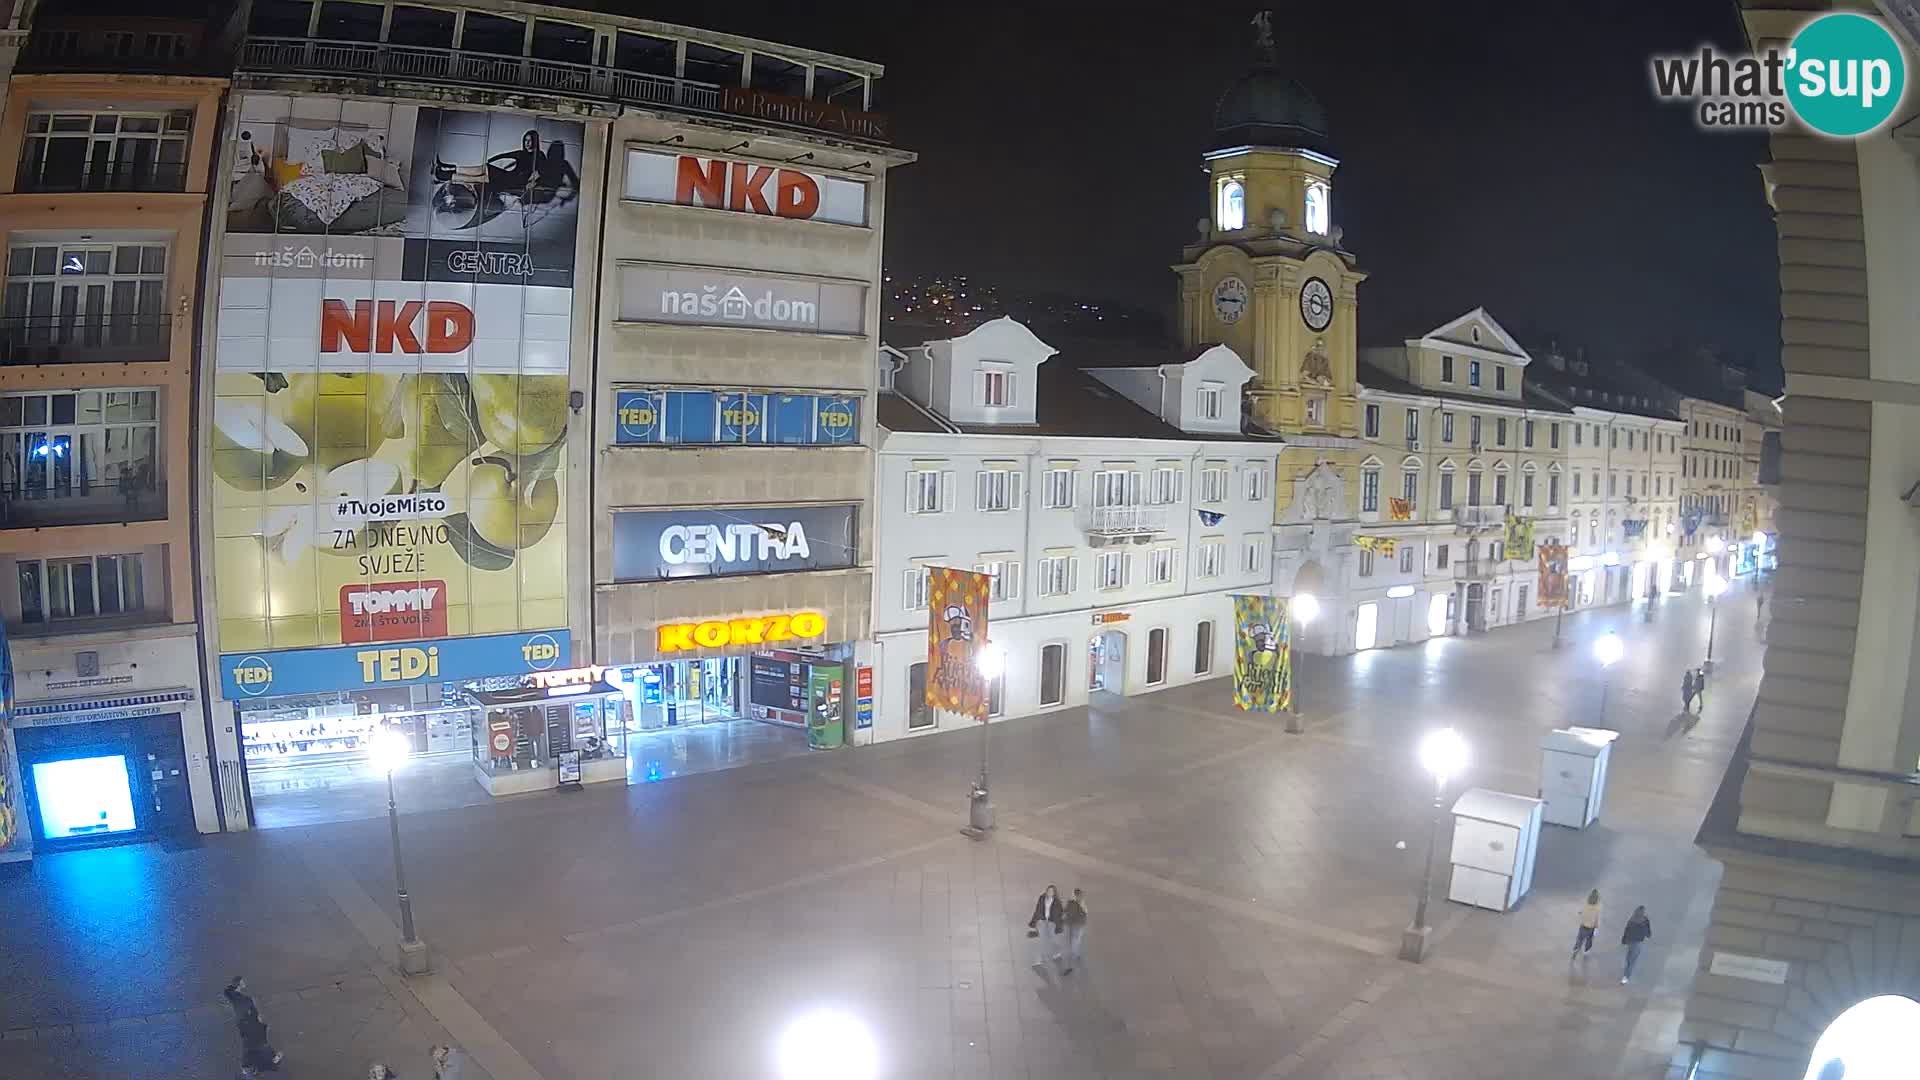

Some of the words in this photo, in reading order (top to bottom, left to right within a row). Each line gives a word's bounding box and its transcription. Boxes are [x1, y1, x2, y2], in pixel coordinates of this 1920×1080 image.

[675, 155, 820, 220] NKD
[448, 250, 534, 275] CENTRA
[320, 298, 476, 354] NKD
[619, 408, 657, 425] TEDi
[337, 497, 446, 517] #TvojeMisto
[333, 529, 357, 550] ZA
[368, 524, 450, 548] DNEVNO
[659, 521, 810, 564] CENTRA
[359, 547, 425, 576] SVJEŽE
[348, 587, 439, 615] TOMMY
[657, 612, 826, 652] KORZO
[357, 646, 440, 683] TEDi
[522, 641, 560, 662] TEDi
[233, 666, 273, 685] TEDi
